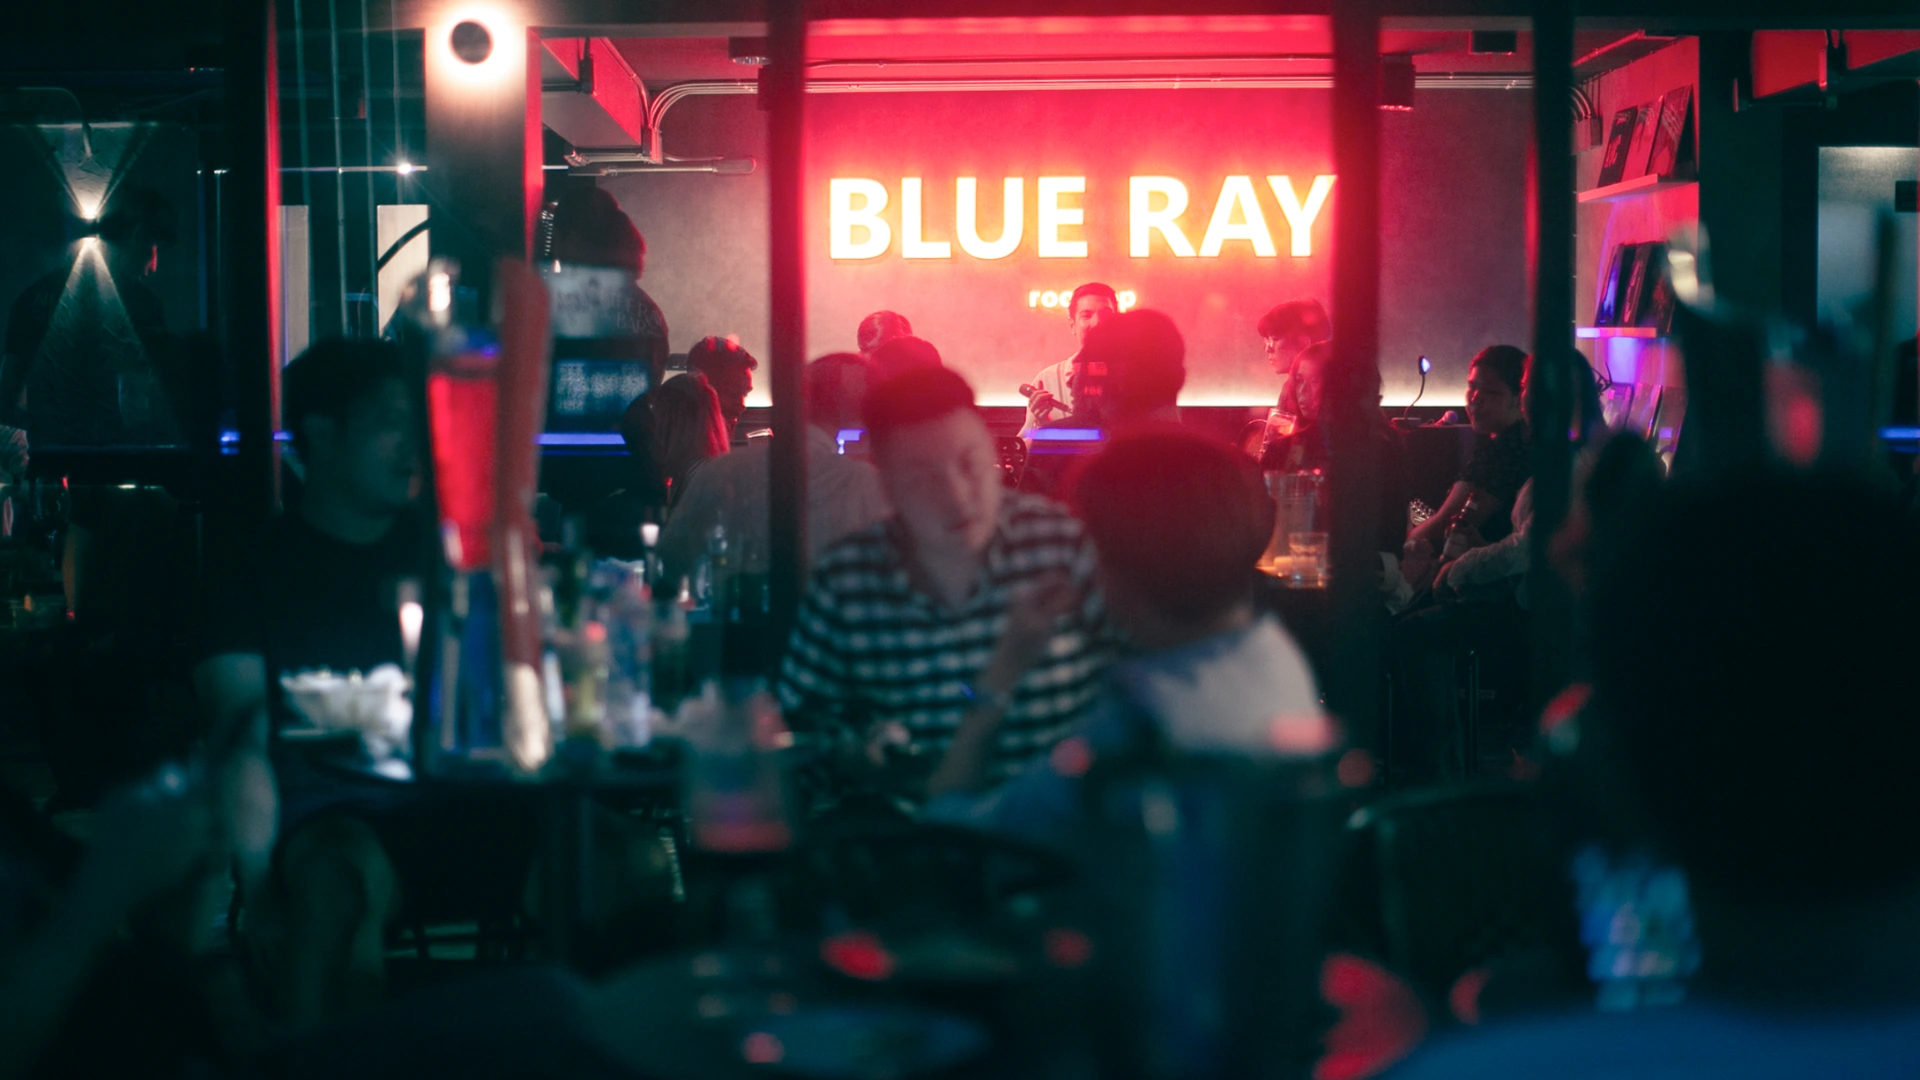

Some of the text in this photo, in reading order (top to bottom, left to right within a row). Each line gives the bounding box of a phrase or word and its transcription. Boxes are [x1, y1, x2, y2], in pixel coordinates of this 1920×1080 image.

[829, 175, 1336, 259] BLUE RAY
[1029, 290, 1136, 313] roop
